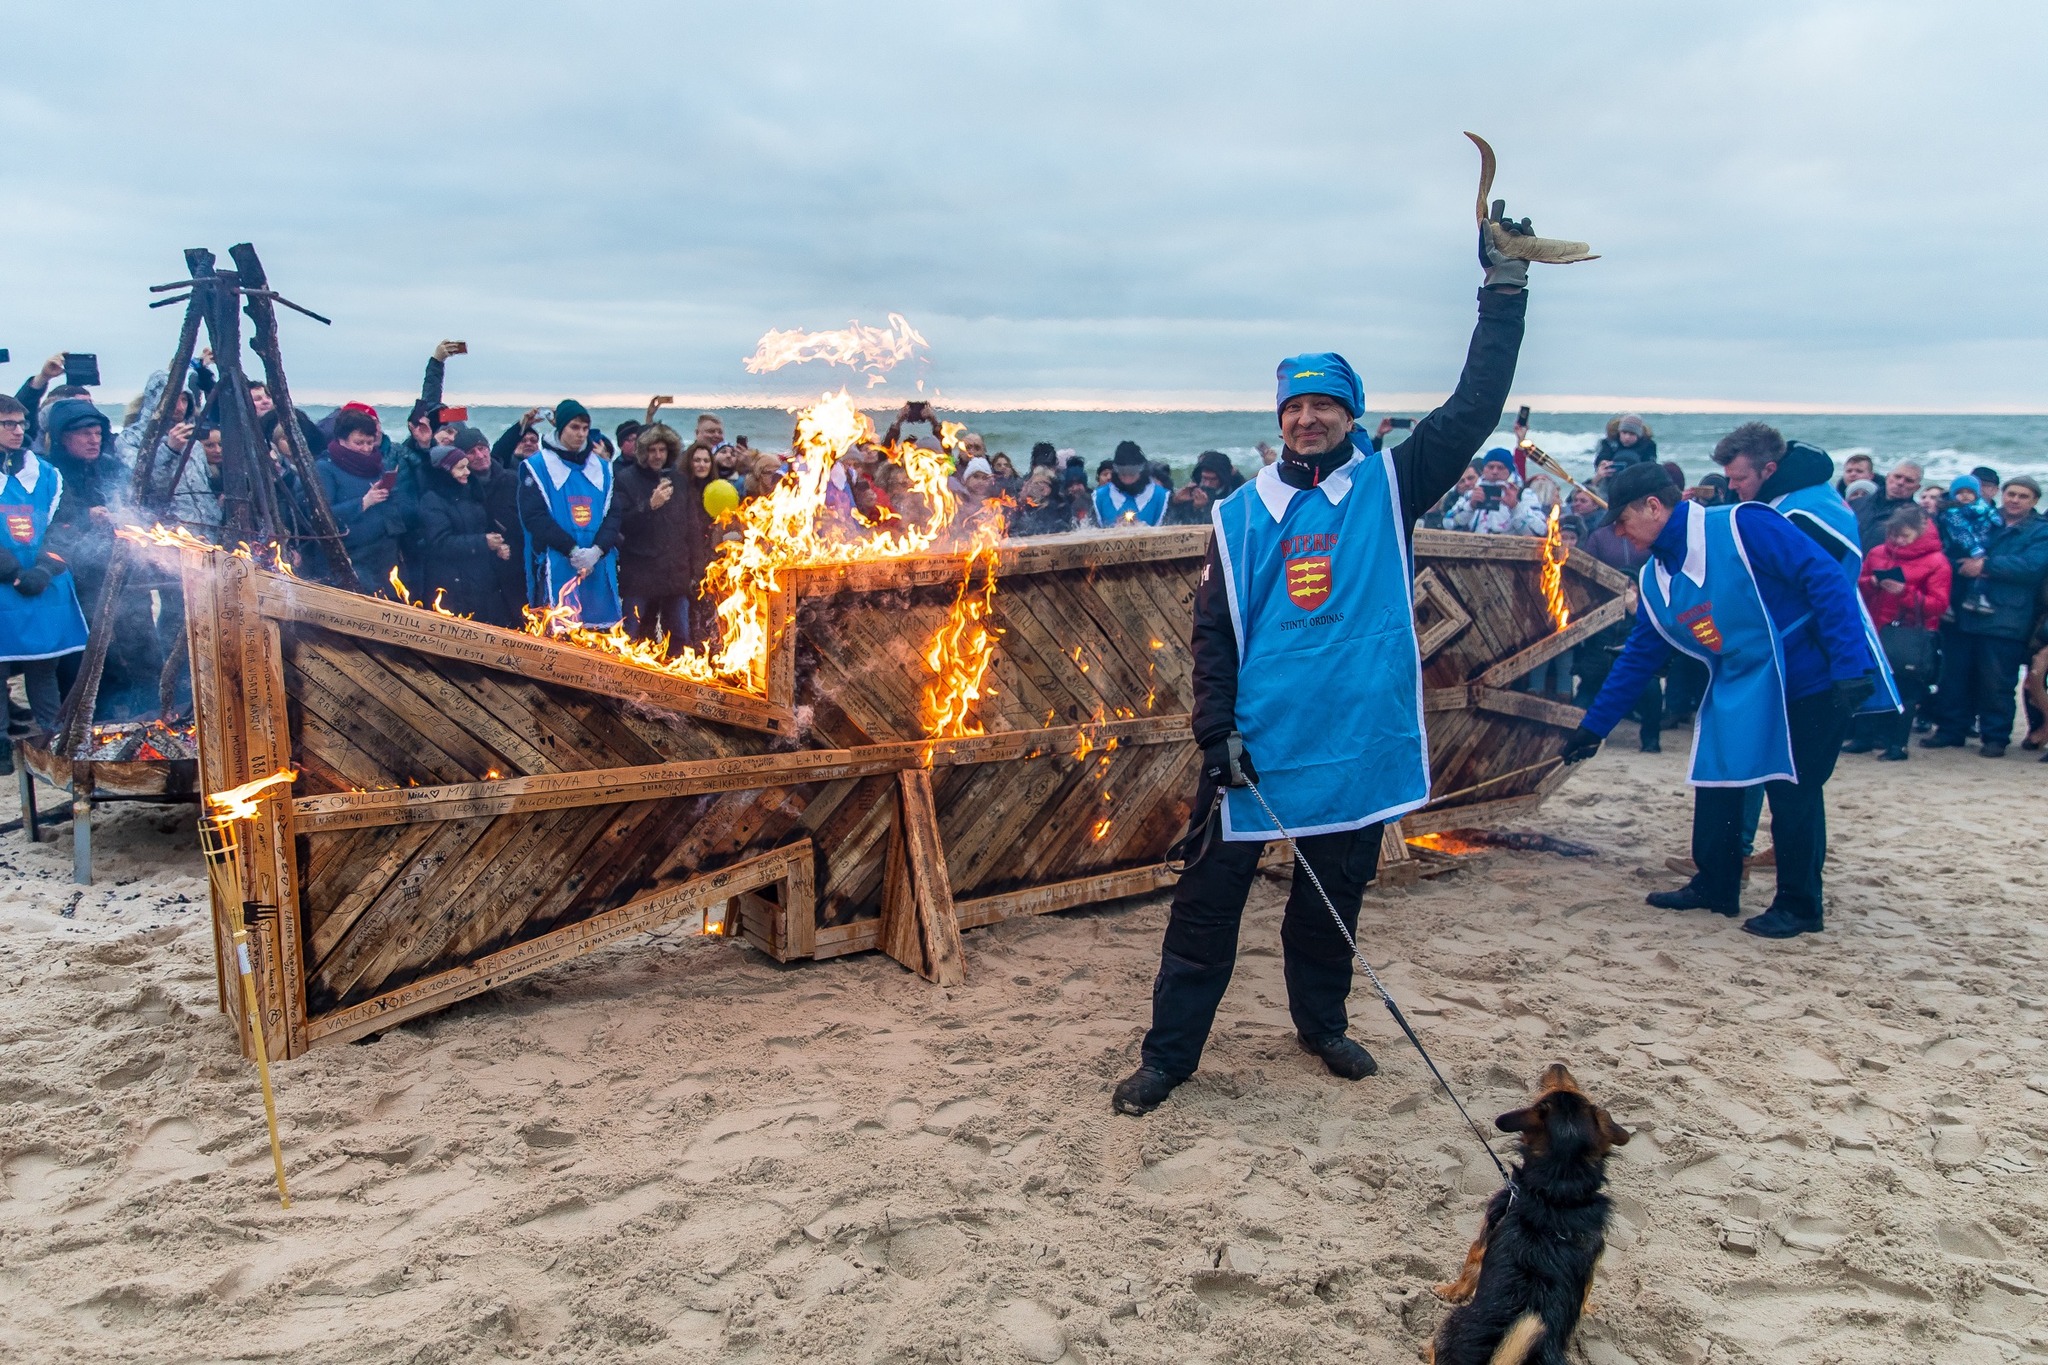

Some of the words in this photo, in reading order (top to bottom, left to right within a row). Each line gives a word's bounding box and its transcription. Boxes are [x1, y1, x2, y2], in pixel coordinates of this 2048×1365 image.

[1309, 613, 1345, 626] ORDINAS
[244, 667, 259, 701] VISADA
[248, 702, 262, 731] KARTU
[522, 774, 581, 792] STINTA
